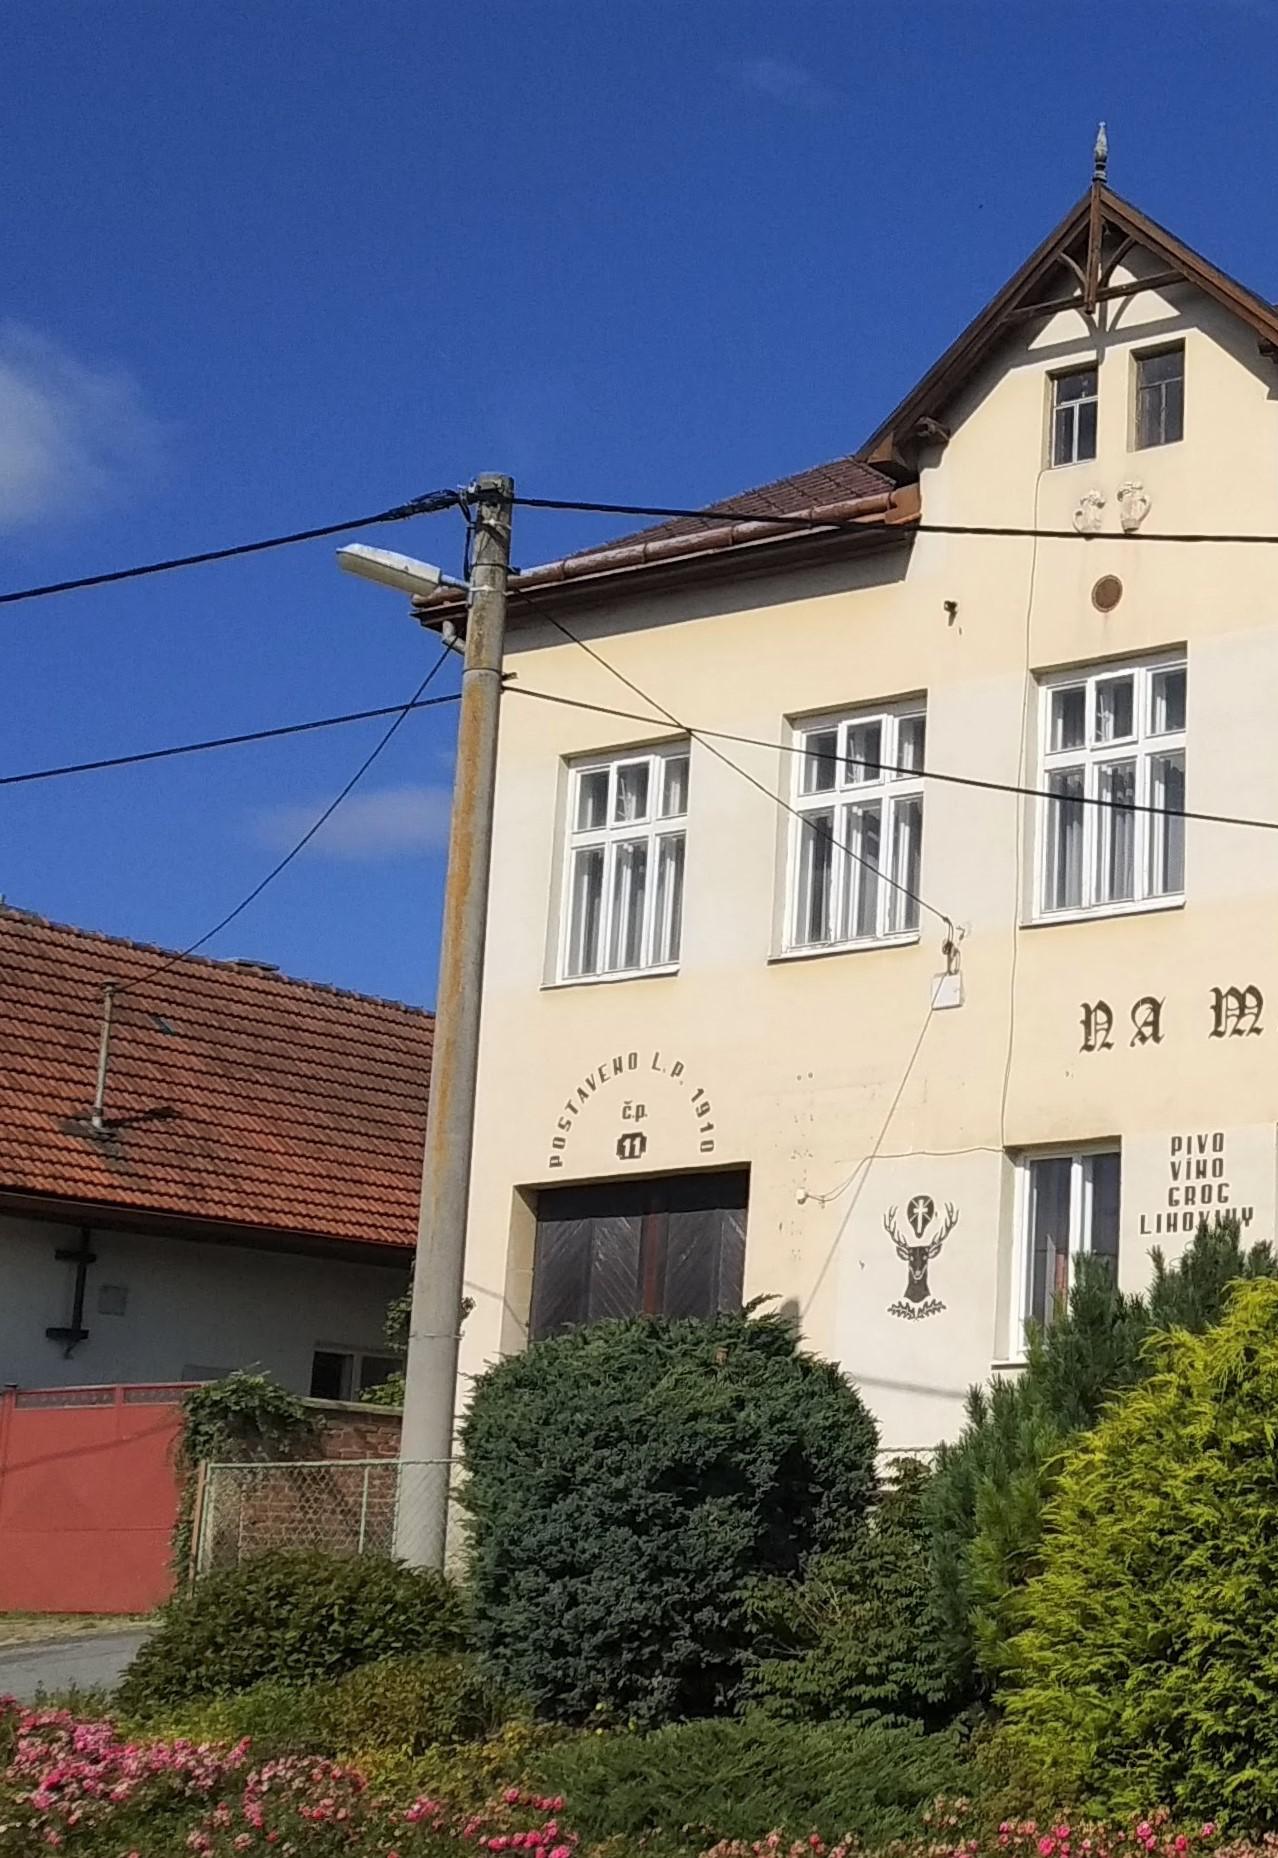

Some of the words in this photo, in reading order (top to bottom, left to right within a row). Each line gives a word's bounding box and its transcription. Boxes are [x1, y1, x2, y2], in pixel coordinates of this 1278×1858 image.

[1079, 996, 1165, 1053] NA
[548, 1052, 638, 1168] POSTAVENO
[691, 1088, 715, 1153] 1910
[622, 1136, 642, 1158] 11
[1170, 1132, 1225, 1157] PIVO
[1170, 1157, 1224, 1182] VÍNO
[1168, 1182, 1230, 1207] GROG
